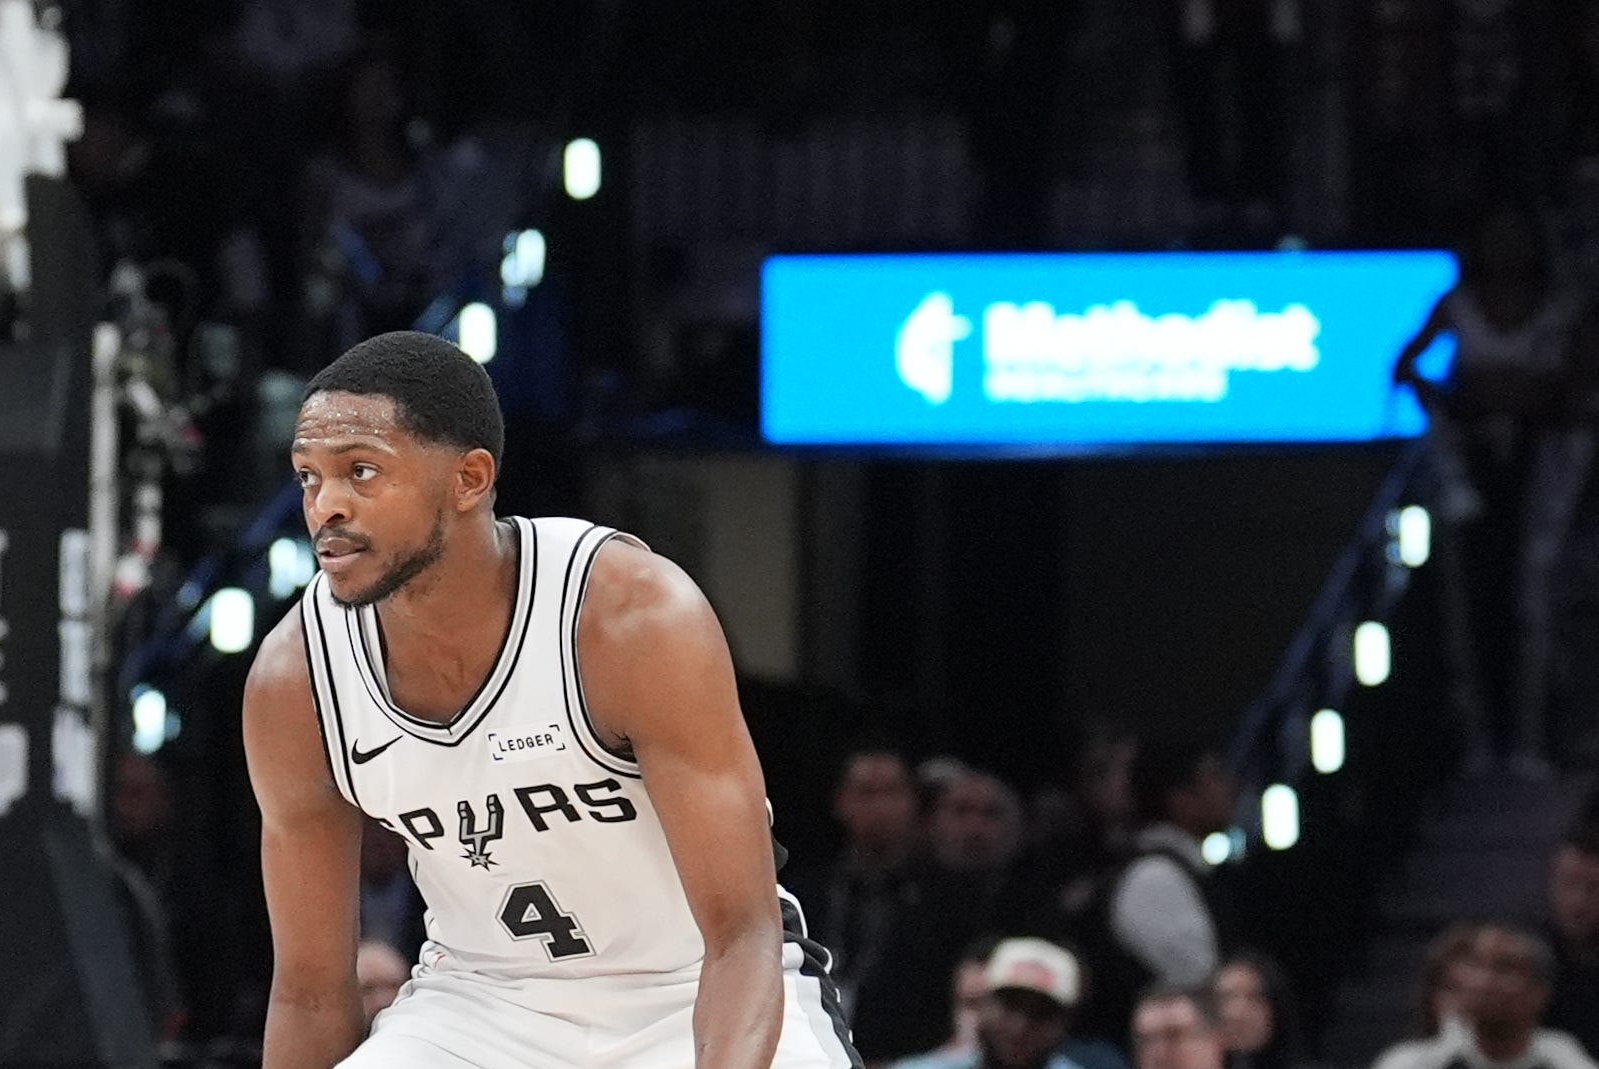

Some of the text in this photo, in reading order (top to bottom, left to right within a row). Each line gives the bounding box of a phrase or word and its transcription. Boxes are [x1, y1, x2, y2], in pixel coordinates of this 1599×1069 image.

[498, 732, 555, 752] LEDGER
[398, 777, 638, 871] PURS
[495, 879, 597, 963] 4
